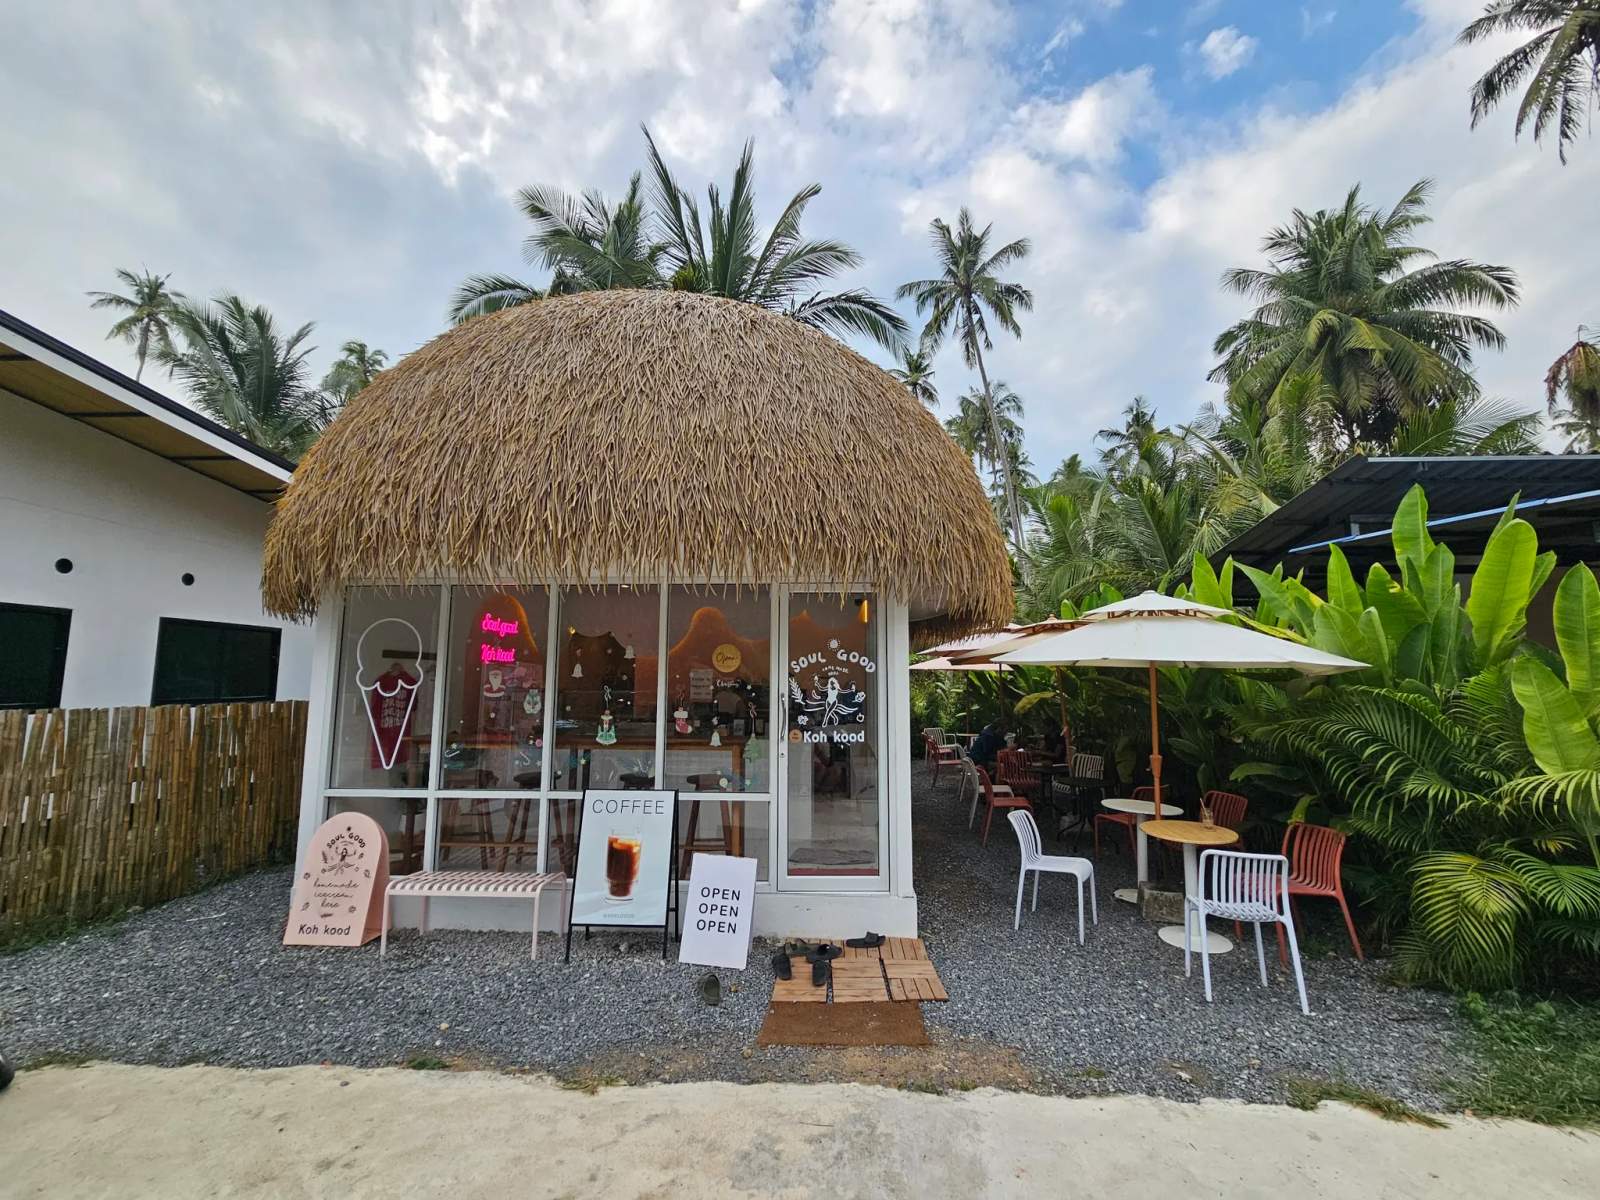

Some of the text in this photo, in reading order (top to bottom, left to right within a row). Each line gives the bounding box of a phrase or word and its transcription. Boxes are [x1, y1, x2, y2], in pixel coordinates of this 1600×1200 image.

[791, 649, 876, 673] SOUL GOOD
[803, 731, 827, 743] Koh
[833, 730, 865, 743] kood
[592, 799, 665, 815] COFFEE
[326, 832, 366, 849] SOUL GOOD
[701, 886, 741, 901] OPEN
[698, 902, 739, 918] OPEN
[298, 923, 351, 936] Koh kood
[696, 919, 737, 934] OPEN
